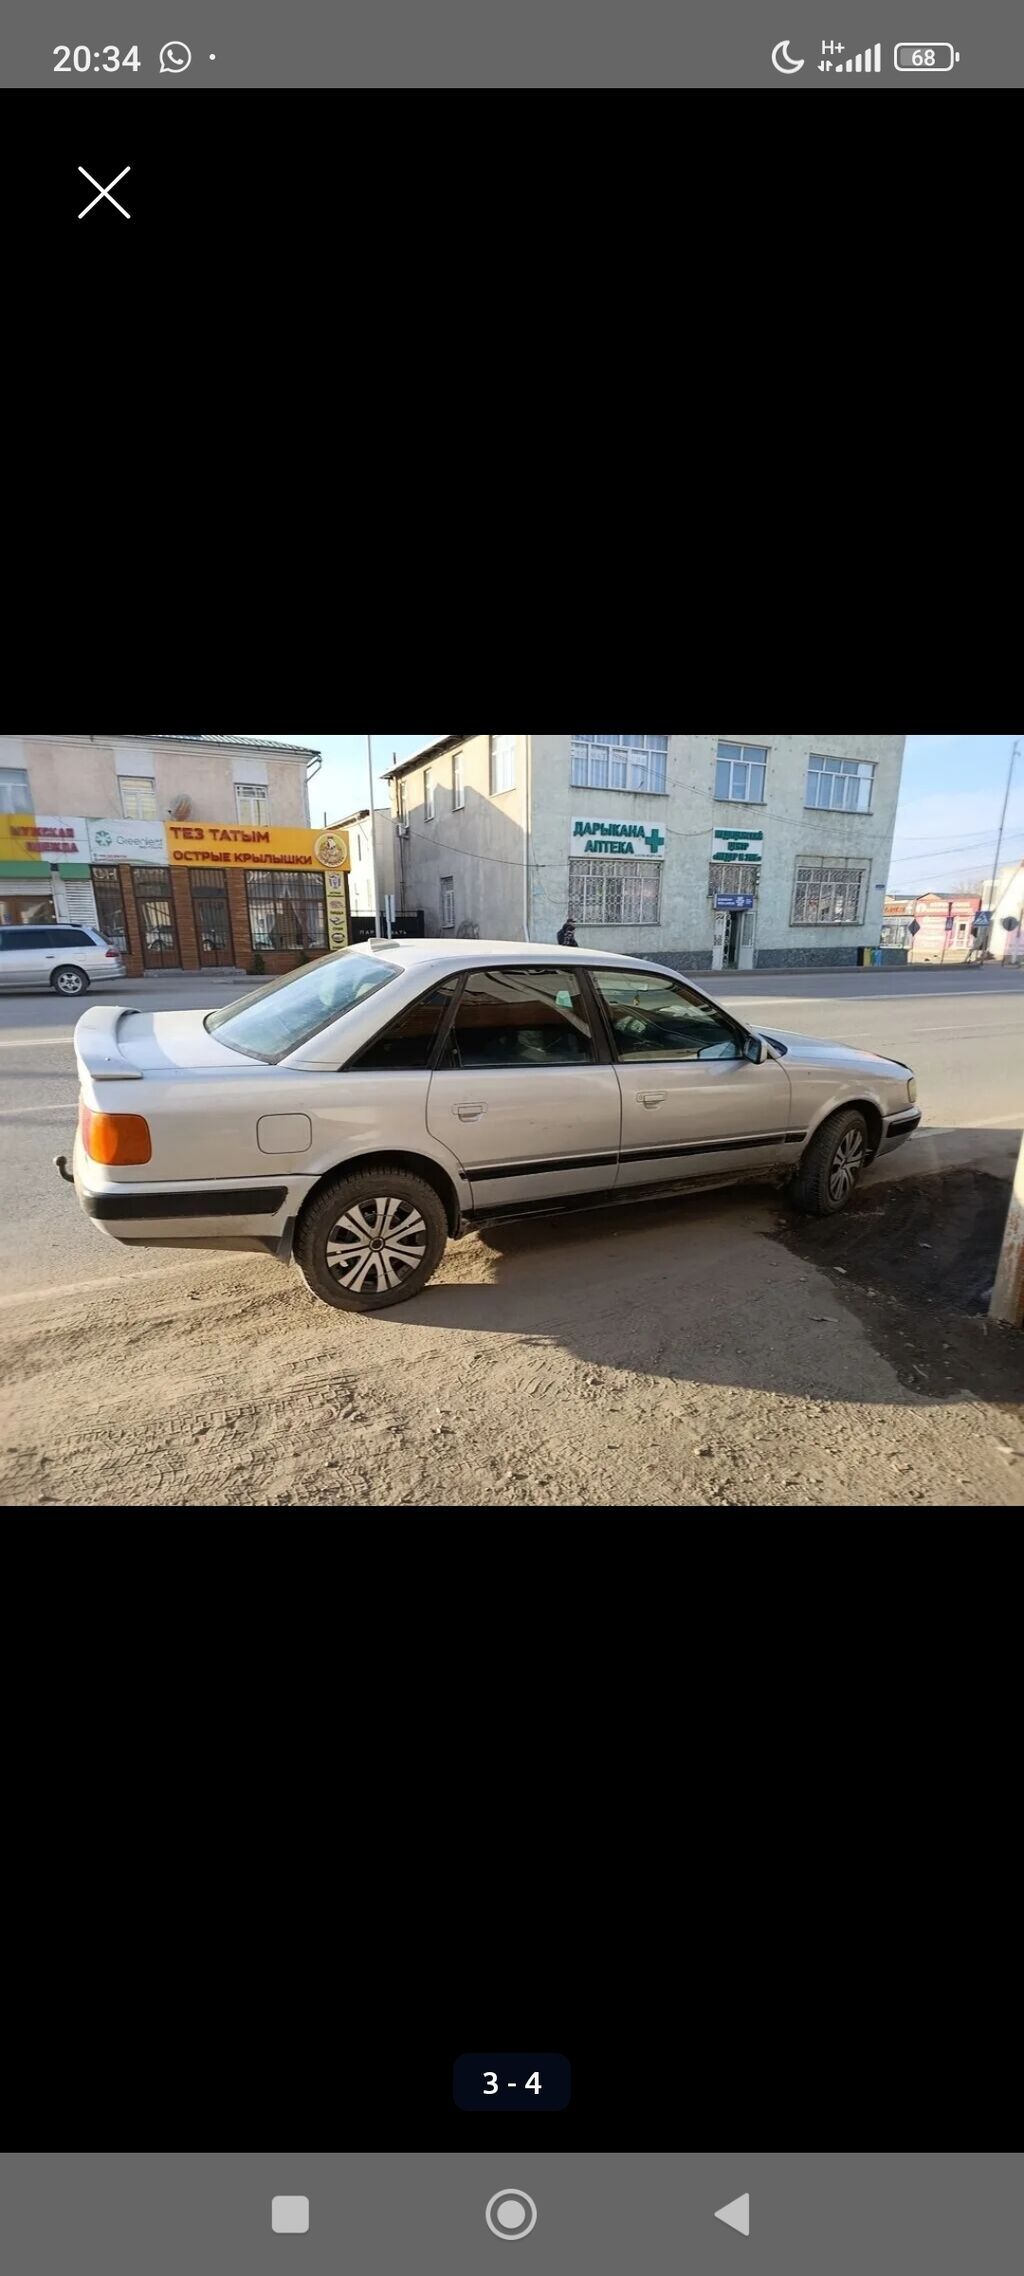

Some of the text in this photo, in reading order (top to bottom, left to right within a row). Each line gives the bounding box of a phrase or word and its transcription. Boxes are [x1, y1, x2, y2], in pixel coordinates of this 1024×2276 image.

[170, 826, 270, 843] ТЕЗ ТАТЫМ
[573, 821, 645, 839] ДАРЫКАНА
[584, 839, 634, 854] АПТЕКА
[173, 850, 231, 863] ОСТРЫЕ
[234, 854, 313, 865] КРЫЛЫШКИ
